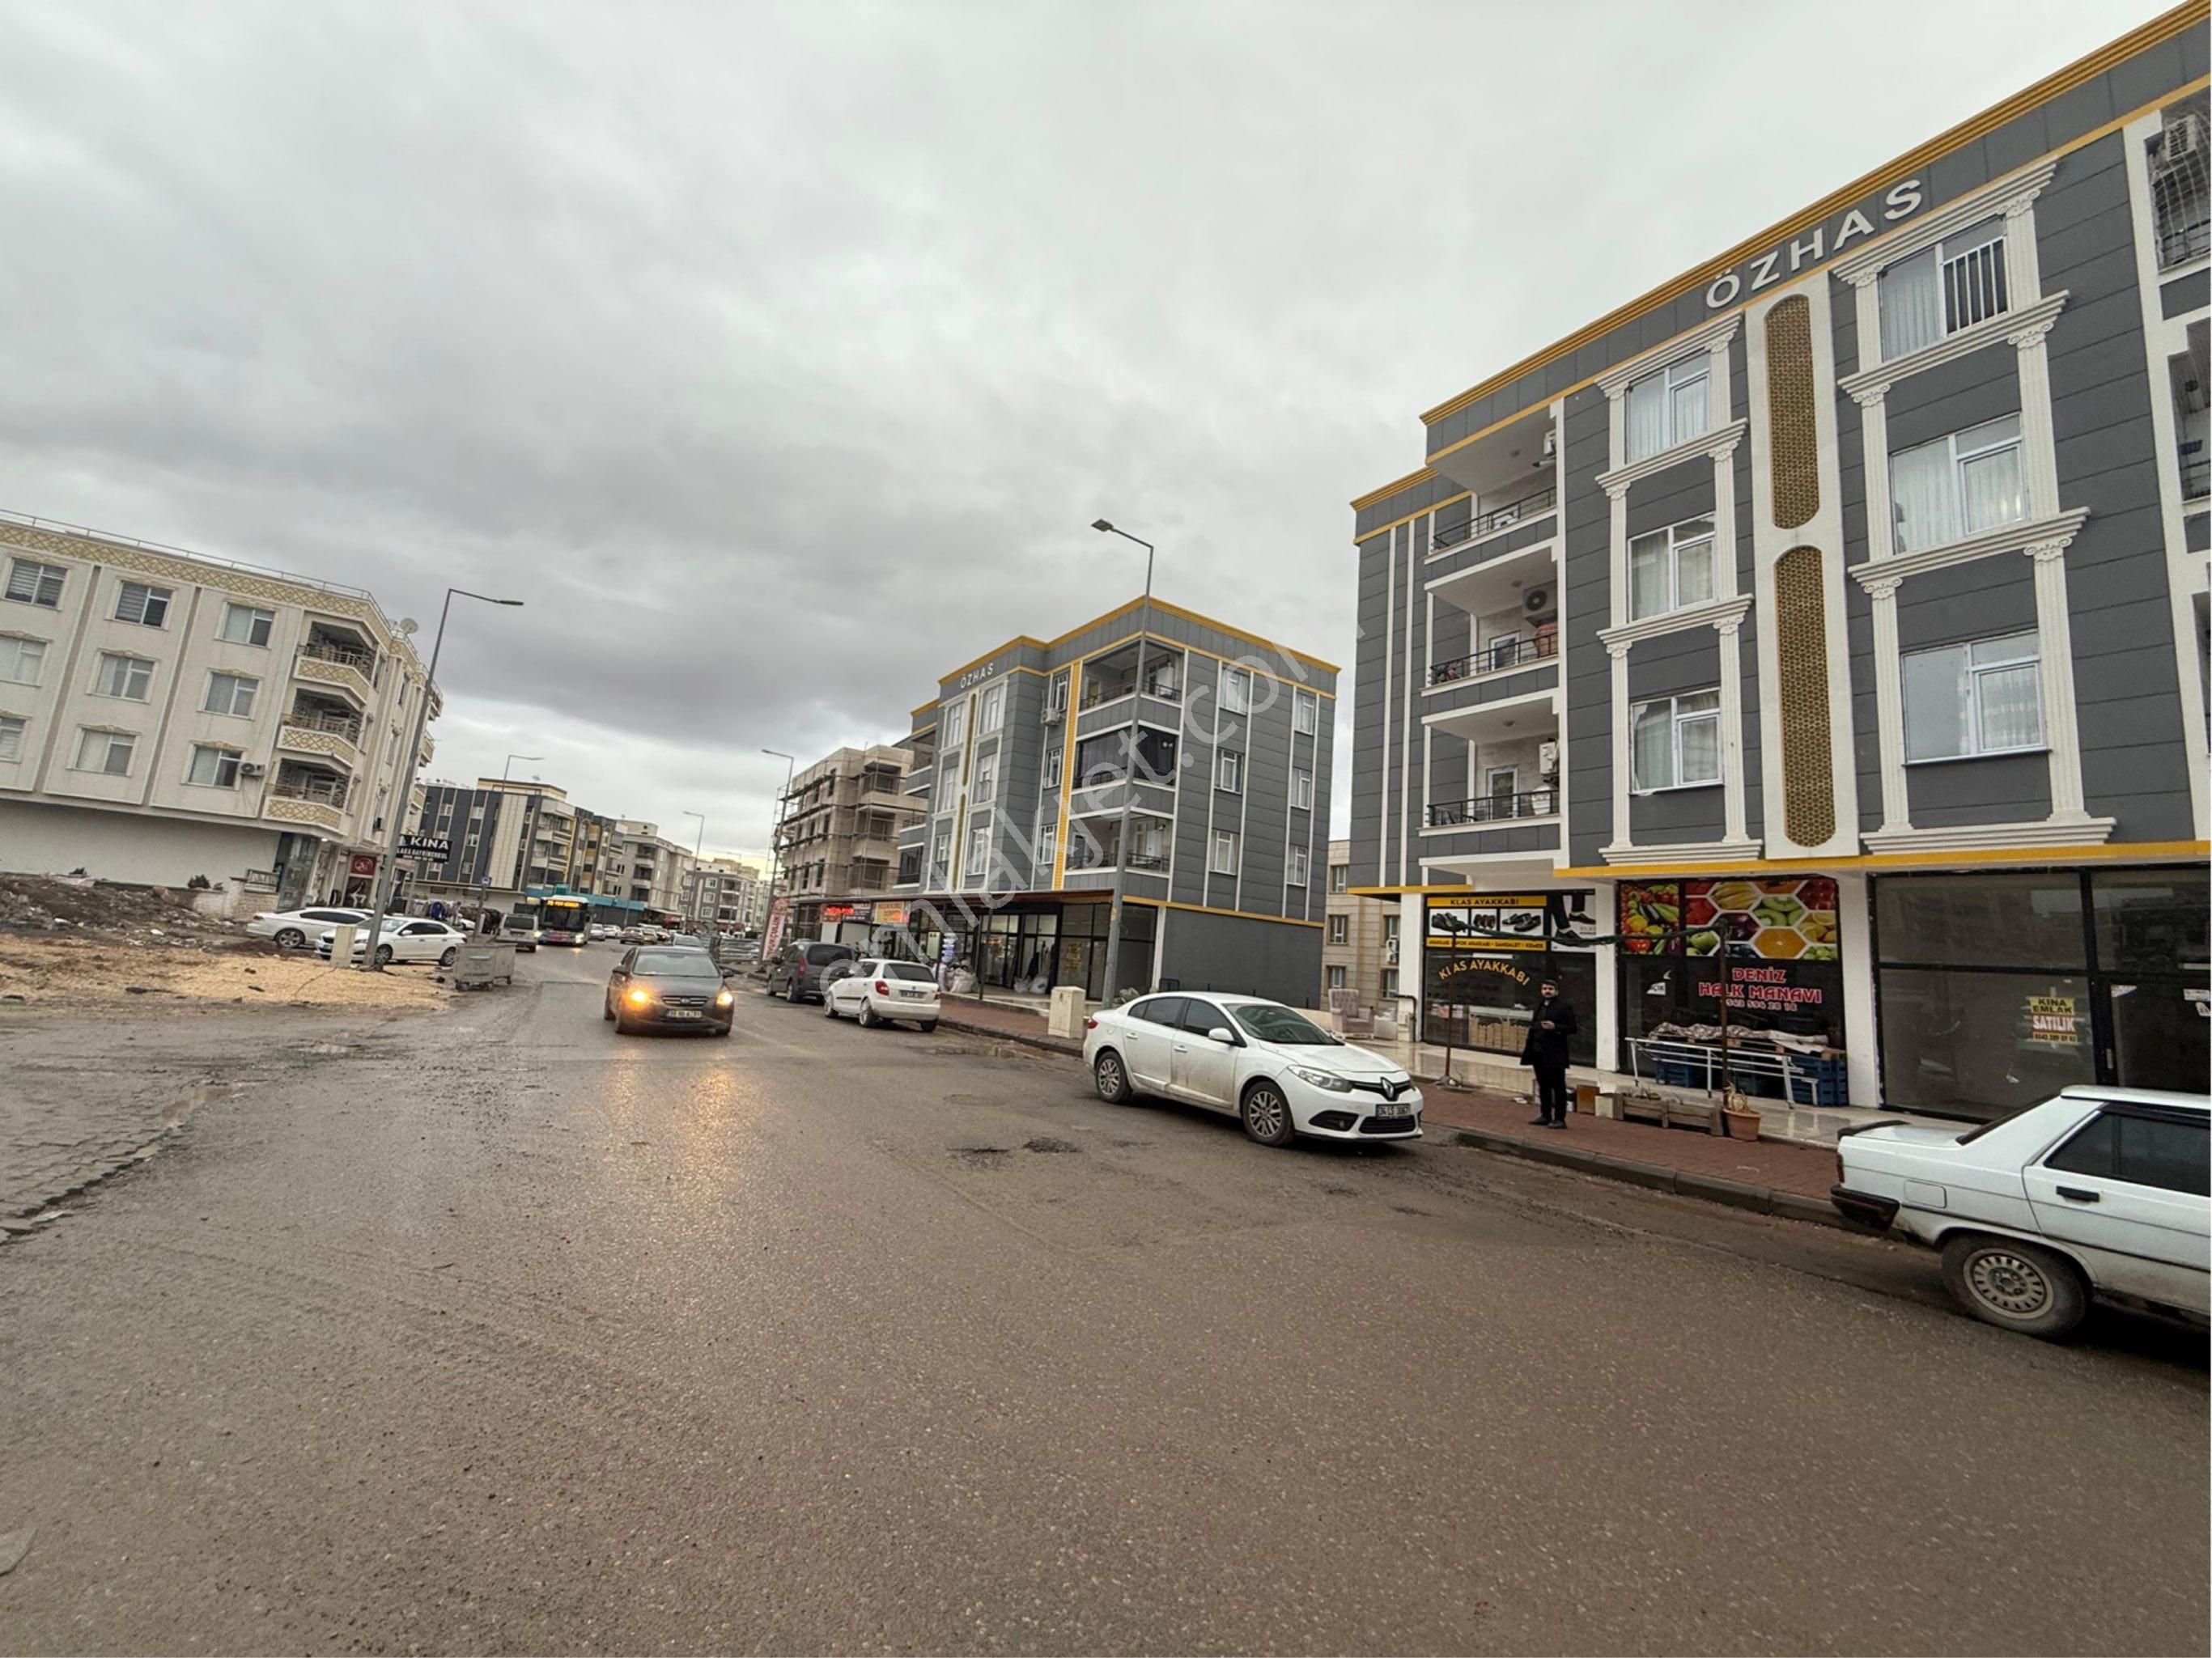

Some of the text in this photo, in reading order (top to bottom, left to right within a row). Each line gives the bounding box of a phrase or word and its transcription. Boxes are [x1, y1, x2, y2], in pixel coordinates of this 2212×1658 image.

[1705, 179, 1922, 308] ÖZHAS
[960, 662, 994, 689] ÖZHAS
[410, 836, 449, 850] KINA
[1470, 959, 1531, 986] AYAKKABI
[1732, 967, 1787, 983] DENİZ
[1748, 984, 1822, 1003] MANAVI
[2032, 1005, 2072, 1013] EMLAK
[2039, 998, 2066, 1007] KINA
[2032, 1015, 2075, 1032] SATILIK
